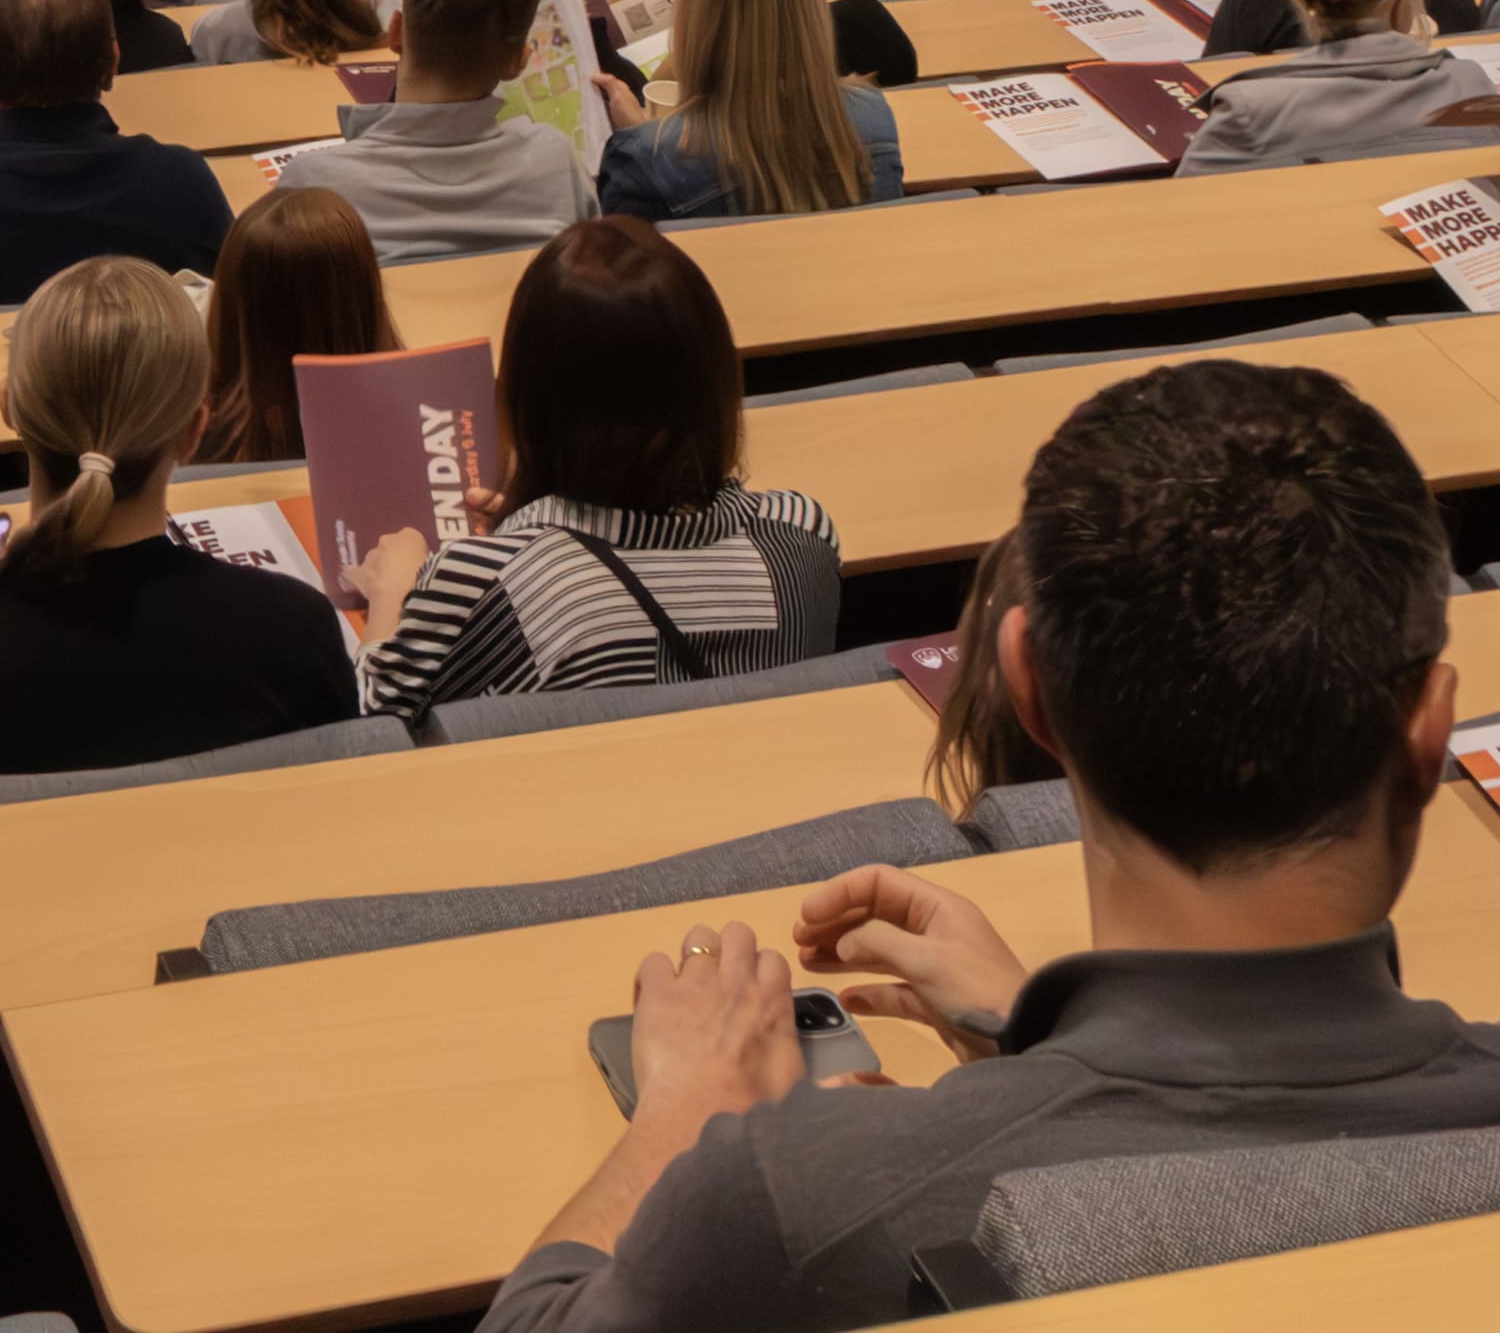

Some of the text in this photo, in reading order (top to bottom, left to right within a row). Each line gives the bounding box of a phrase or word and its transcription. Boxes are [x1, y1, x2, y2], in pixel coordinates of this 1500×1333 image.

[1059, 4, 1114, 18] MORE
[1069, 9, 1145, 27] HAPPEN
[969, 82, 1035, 102] MAKE
[980, 91, 1044, 110] MORE
[989, 98, 1080, 120] HAPPEN
[1404, 189, 1478, 223] MAKE
[1421, 207, 1493, 241] MORE
[418, 403, 461, 484] DAY
